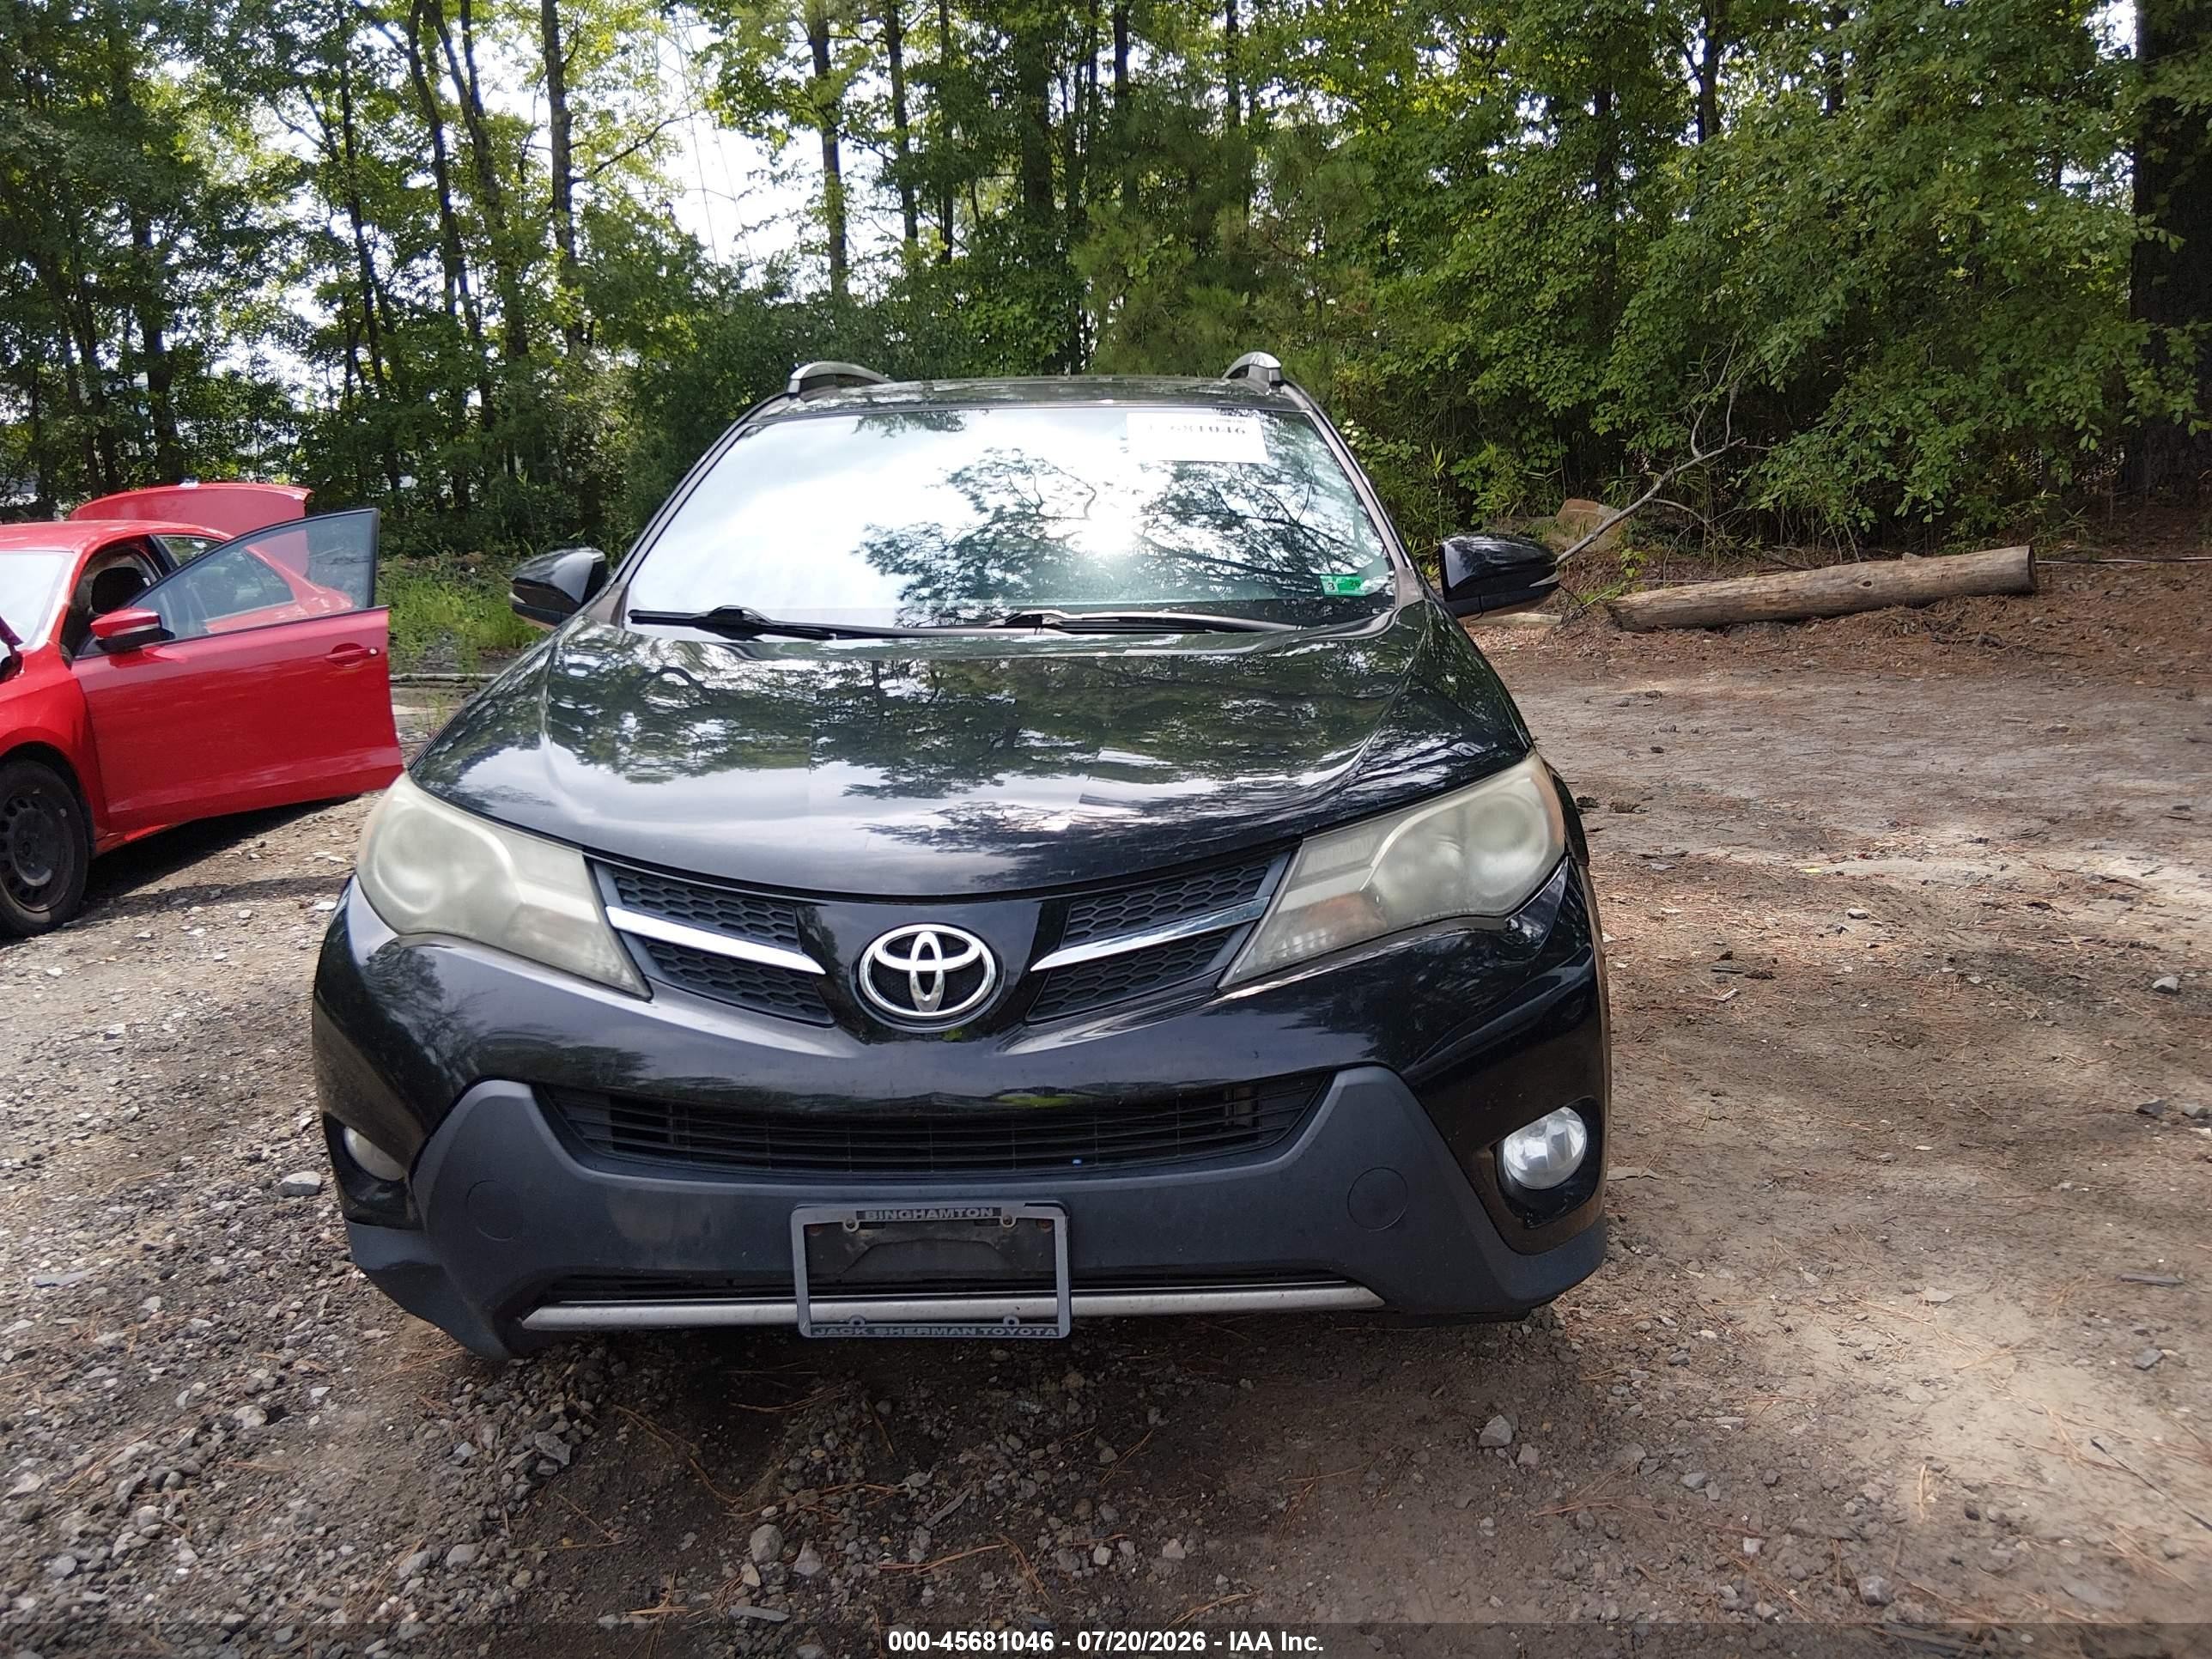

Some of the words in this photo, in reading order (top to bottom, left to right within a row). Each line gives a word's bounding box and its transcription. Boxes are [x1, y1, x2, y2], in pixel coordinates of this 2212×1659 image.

[865, 1207, 994, 1220] BINGHAMTON
[813, 1327, 868, 1335] JACK
[874, 1327, 976, 1335] SHERMAN
[980, 1327, 1058, 1336] TOYOTA
